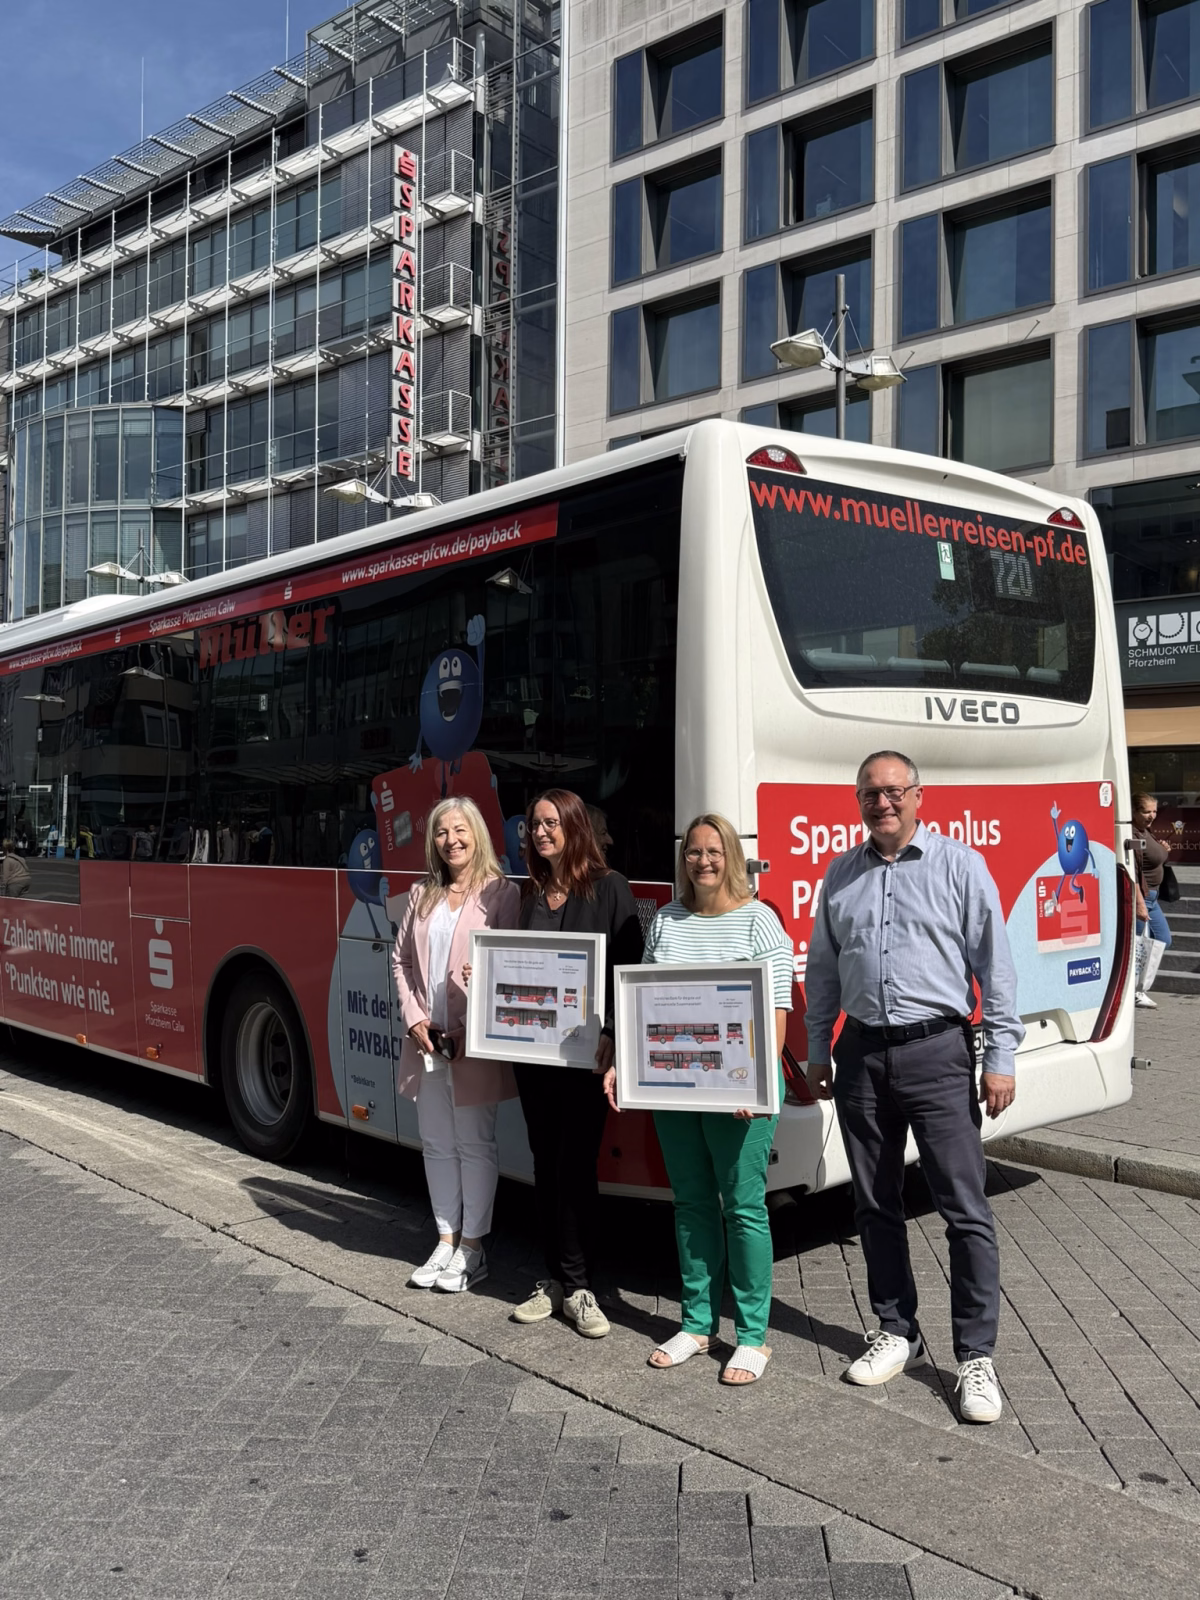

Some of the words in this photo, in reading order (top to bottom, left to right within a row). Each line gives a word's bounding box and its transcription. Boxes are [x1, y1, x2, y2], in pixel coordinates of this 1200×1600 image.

[396, 183, 416, 477] SPARKASSE
[750, 481, 1087, 566] www.muellerreisen-pf.de
[341, 520, 522, 584] www.sparkasse-pfcw.de/payback
[990, 550, 1033, 597] 720
[149, 614, 181, 634] Sparkasse
[182, 605, 216, 625] Pforzheim
[218, 599, 236, 615] Calw
[1128, 644, 1200, 658] SCHMUCKWEL
[1128, 656, 1176, 668] Pforzheim
[925, 696, 1020, 725] IVECO
[949, 809, 1002, 847] plus
[2, 918, 42, 951] Zahlen
[43, 924, 67, 956] wie
[69, 926, 118, 965] immer.
[1069, 966, 1092, 977] PAYBACK
[60, 975, 86, 1009] wie
[88, 980, 115, 1016] nie.
[150, 1001, 178, 1017] Sparkasse
[347, 989, 369, 1016] Mit
[371, 993, 393, 1020] der
[145, 1013, 171, 1030] Pforzheim
